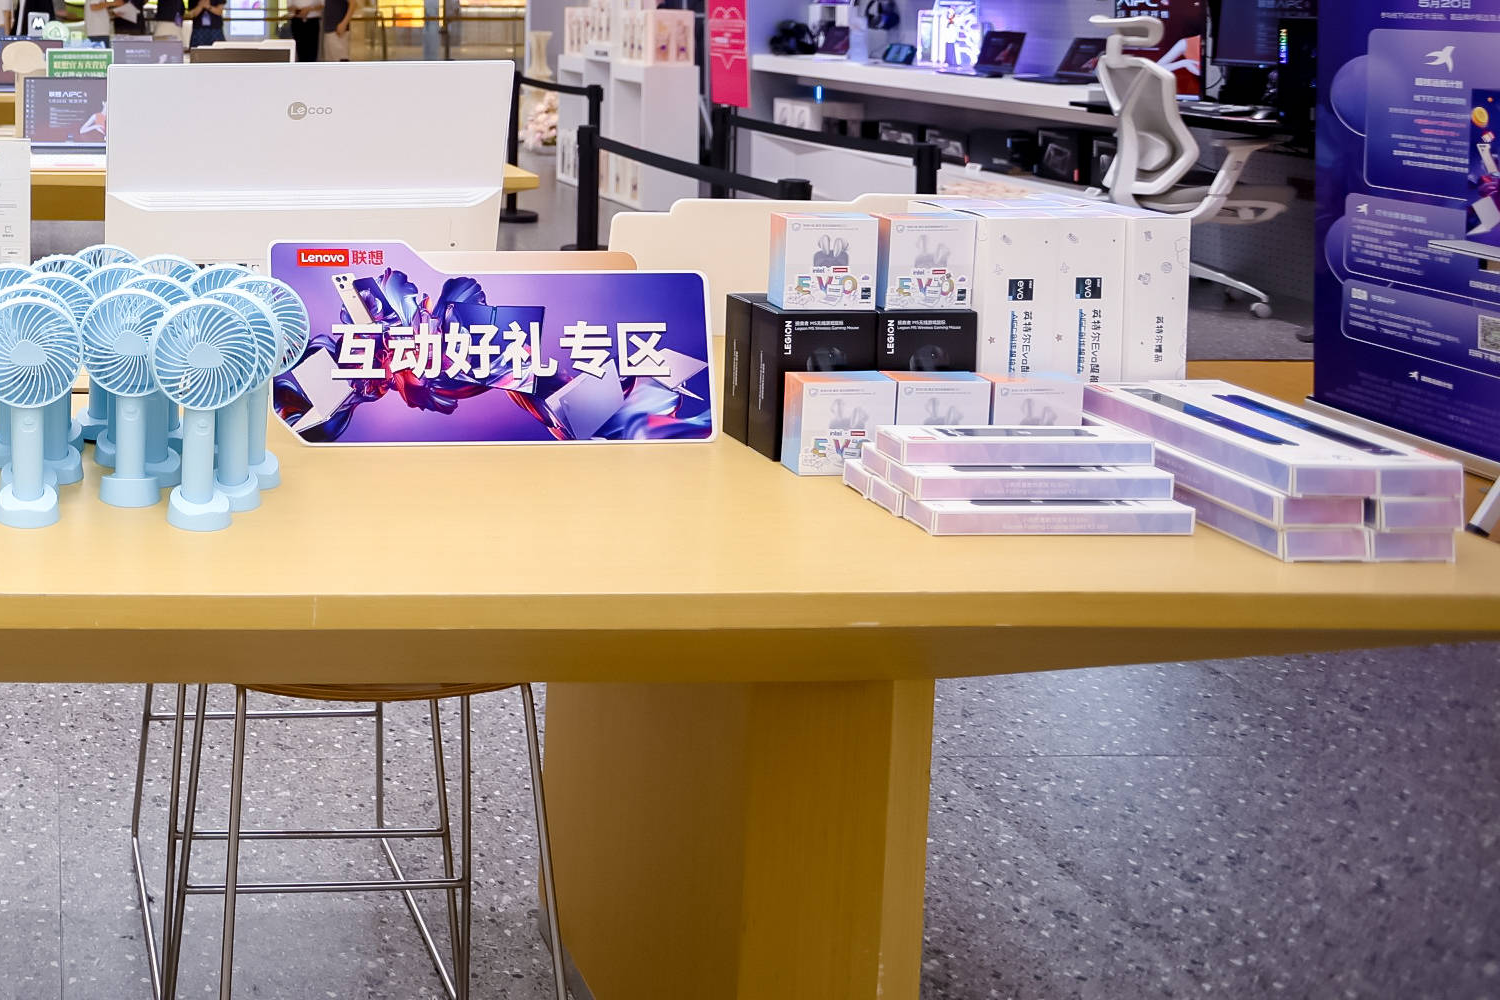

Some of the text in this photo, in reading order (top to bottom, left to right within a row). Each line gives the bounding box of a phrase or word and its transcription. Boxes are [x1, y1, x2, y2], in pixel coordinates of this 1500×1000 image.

[1279, 28, 1289, 64] LEGION
[301, 250, 384, 266] Lenovo 联想
[1084, 278, 1092, 298] evo
[331, 320, 671, 380] 互动好礼专区
[784, 320, 792, 355] LEGION
[886, 319, 895, 354] LEGION
